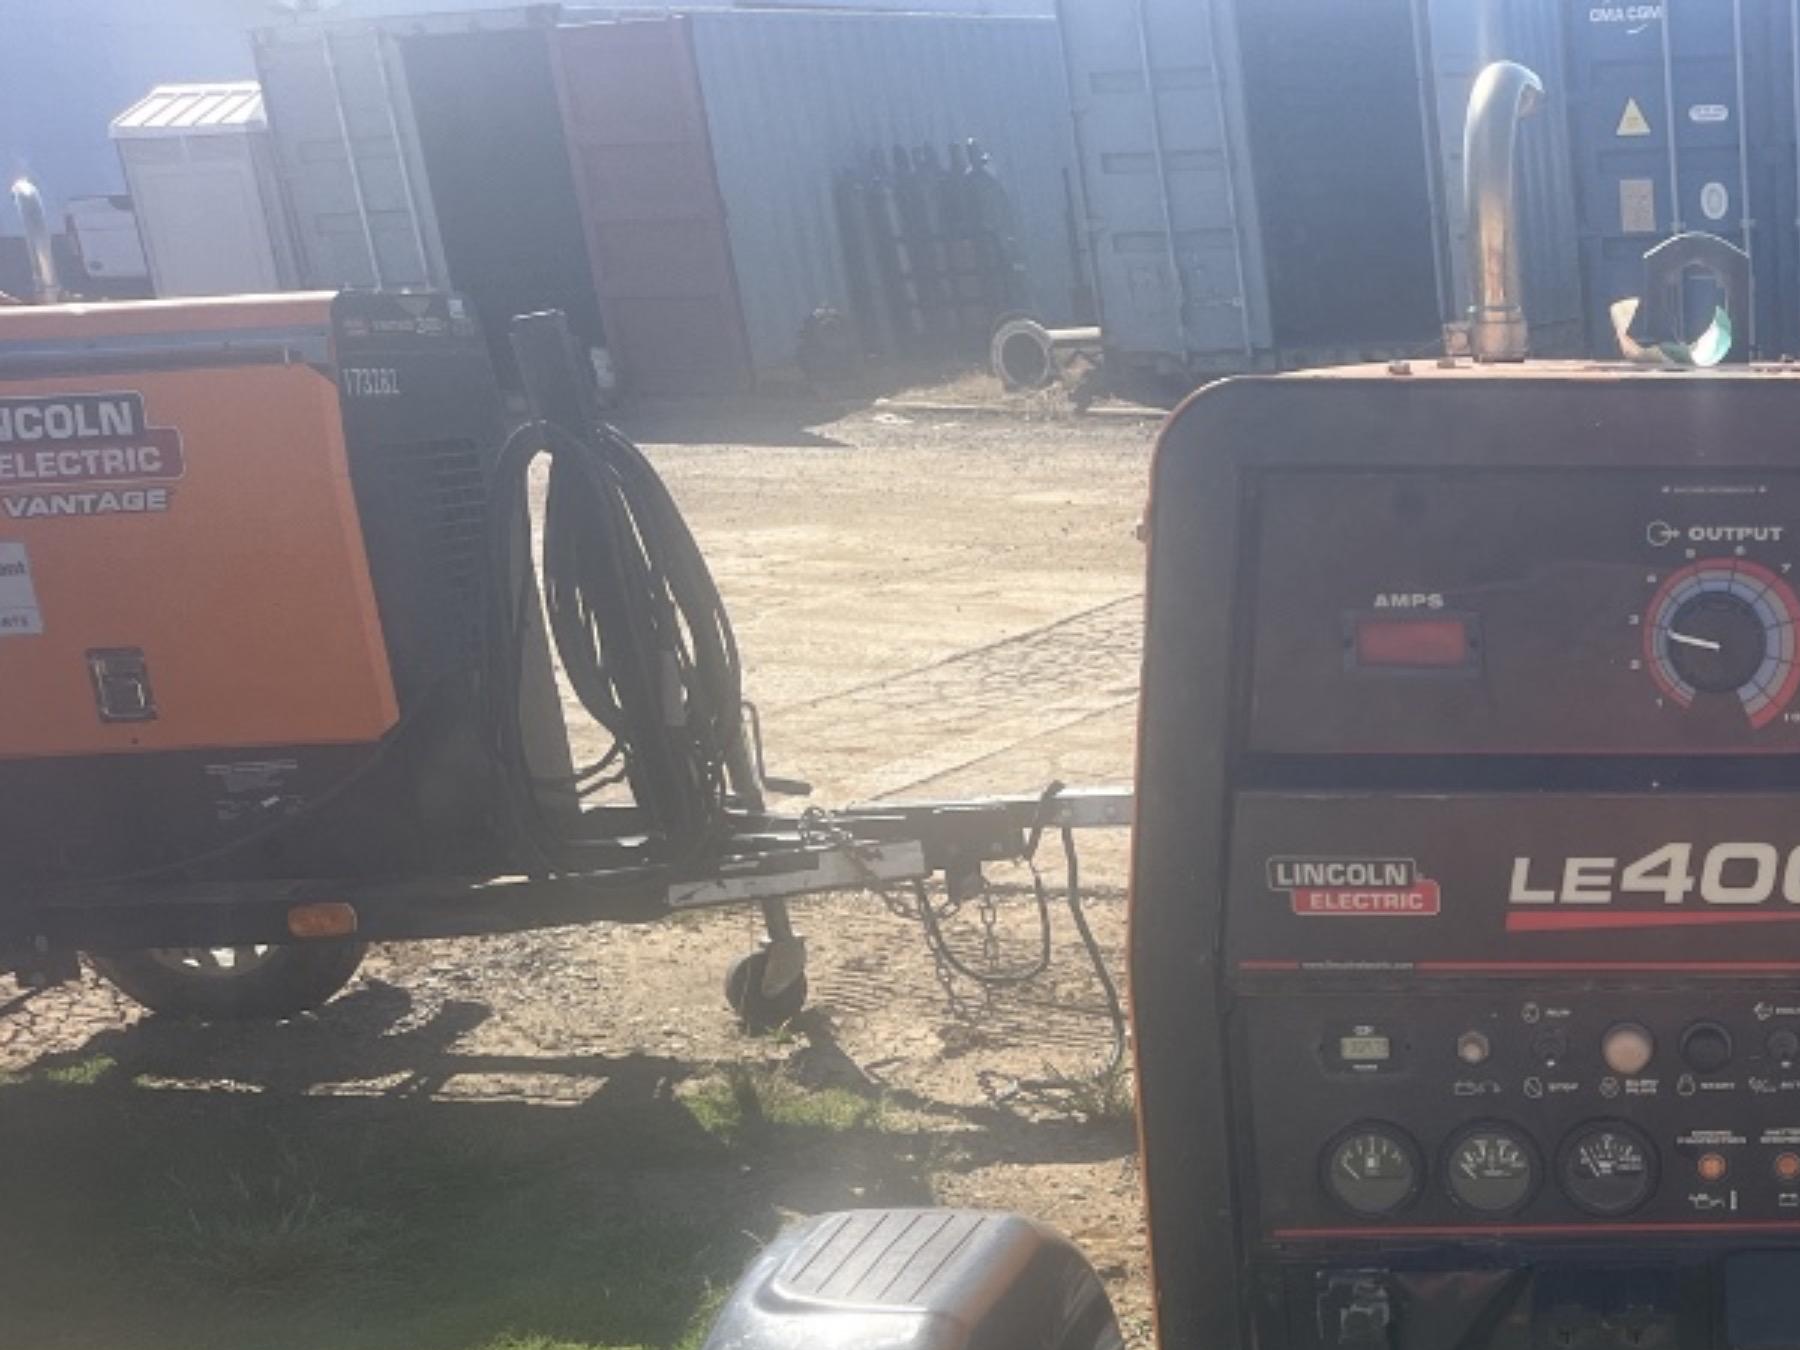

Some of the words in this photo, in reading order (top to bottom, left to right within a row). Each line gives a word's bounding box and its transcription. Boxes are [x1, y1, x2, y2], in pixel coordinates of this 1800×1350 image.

[0, 446, 163, 478] ELECTRIC
[3, 488, 169, 518] VANTAGE
[1688, 527, 1784, 540] OUTPUT
[1373, 593, 1444, 609] AMPS
[1277, 863, 1408, 886] LINCOLN
[1309, 893, 1424, 910] ELECTRIC
